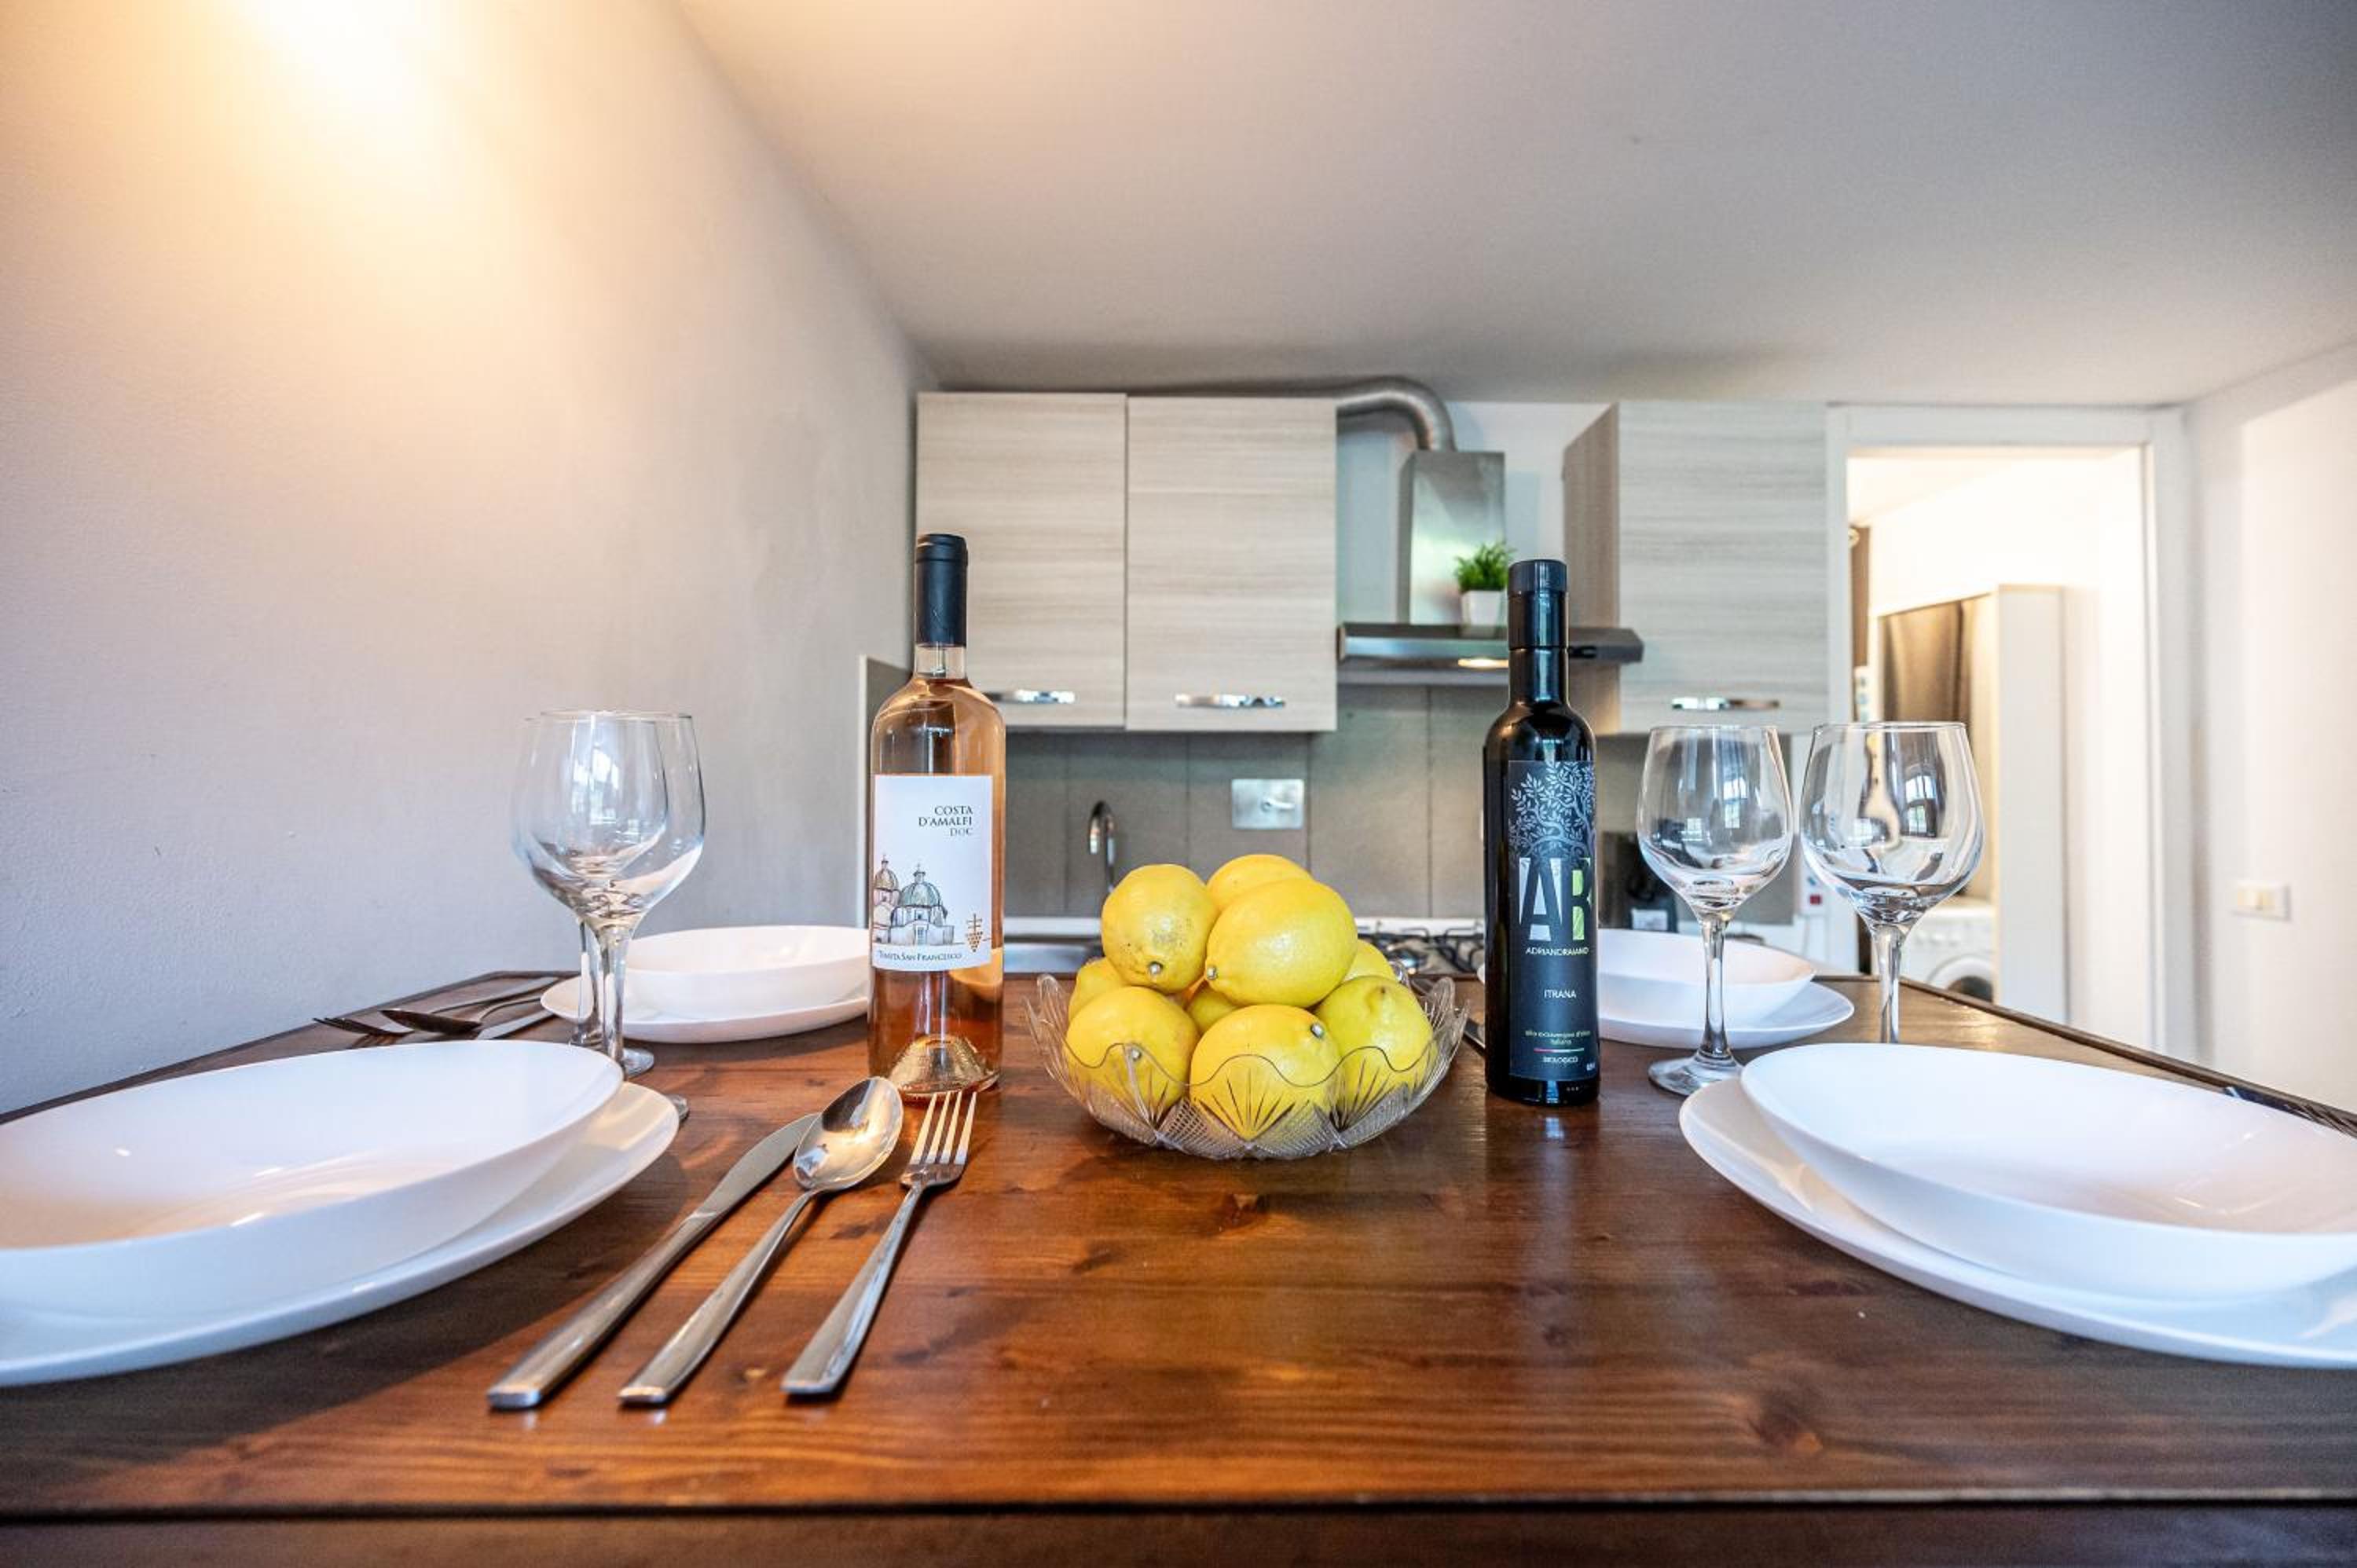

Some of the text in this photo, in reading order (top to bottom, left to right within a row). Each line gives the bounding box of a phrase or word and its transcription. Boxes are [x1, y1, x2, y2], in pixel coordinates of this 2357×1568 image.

[934, 805, 973, 815] COSTA
[918, 816, 972, 826] D'AMALFI
[1544, 989, 1577, 998] ITRANA
